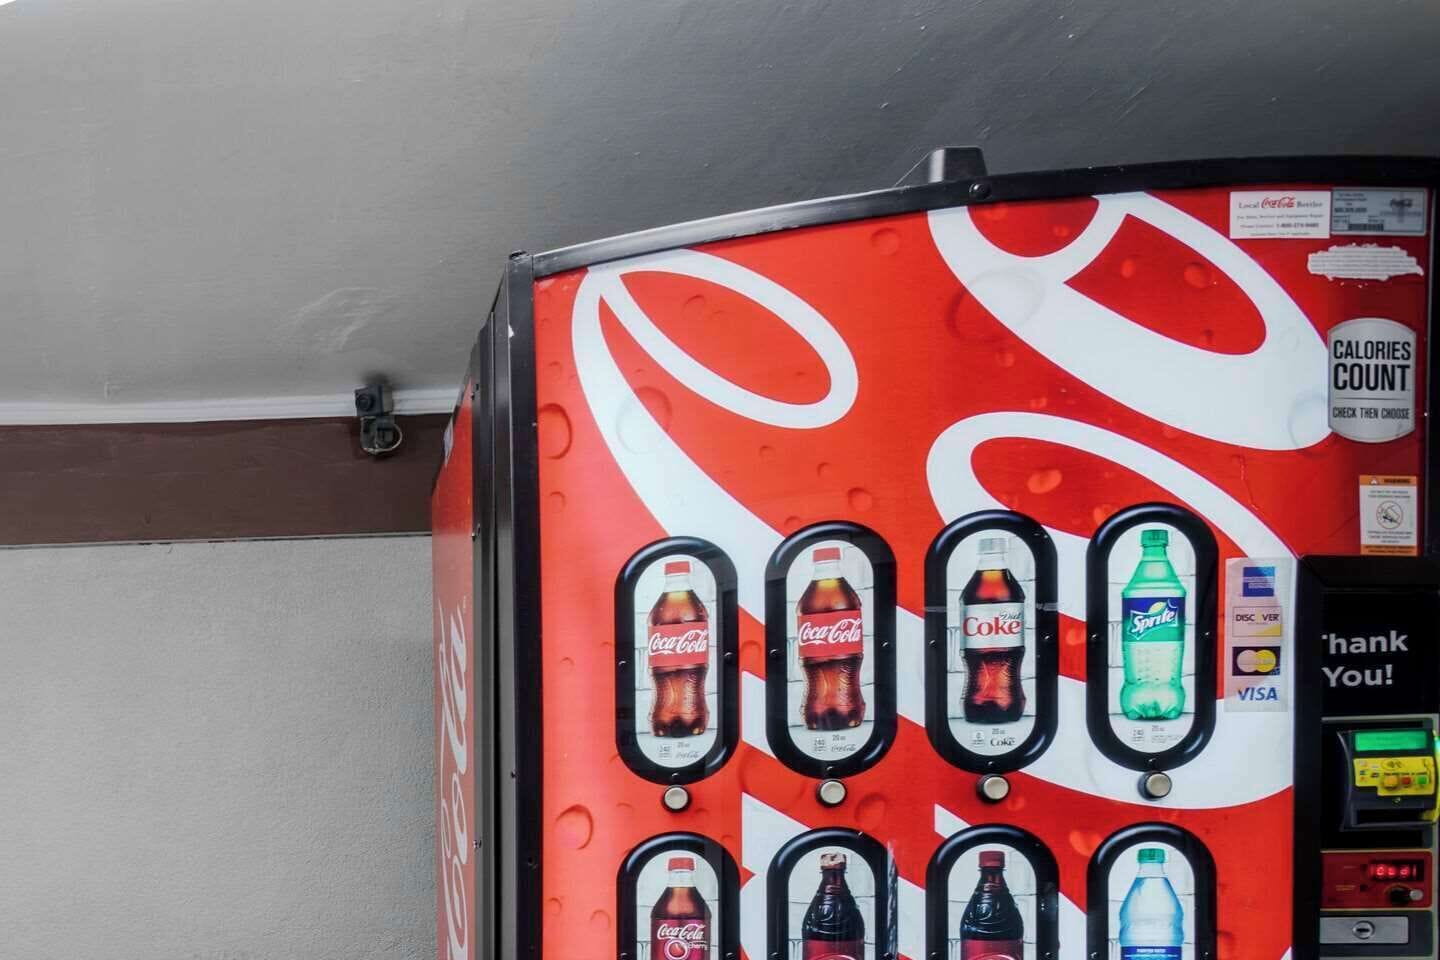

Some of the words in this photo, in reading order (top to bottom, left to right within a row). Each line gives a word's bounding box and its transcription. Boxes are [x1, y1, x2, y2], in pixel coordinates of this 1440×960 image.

[1333, 340, 1411, 362] CALORIES
[1333, 363, 1409, 392] COUNT
[1332, 407, 1357, 419] CHECK
[1359, 407, 1378, 419] THEN
[1380, 407, 1410, 420] CHOOSE
[962, 616, 1023, 637] Coke
[1130, 607, 1177, 634] Sprite
[1235, 613, 1280, 622] DISCVER
[648, 629, 708, 655] Coca-Cola
[799, 618, 864, 645] Coca-Cola
[1321, 630, 1409, 654] hank
[1321, 664, 1393, 688] You!
[1237, 687, 1278, 701] VISA
[657, 923, 706, 940] Coca-Cola
